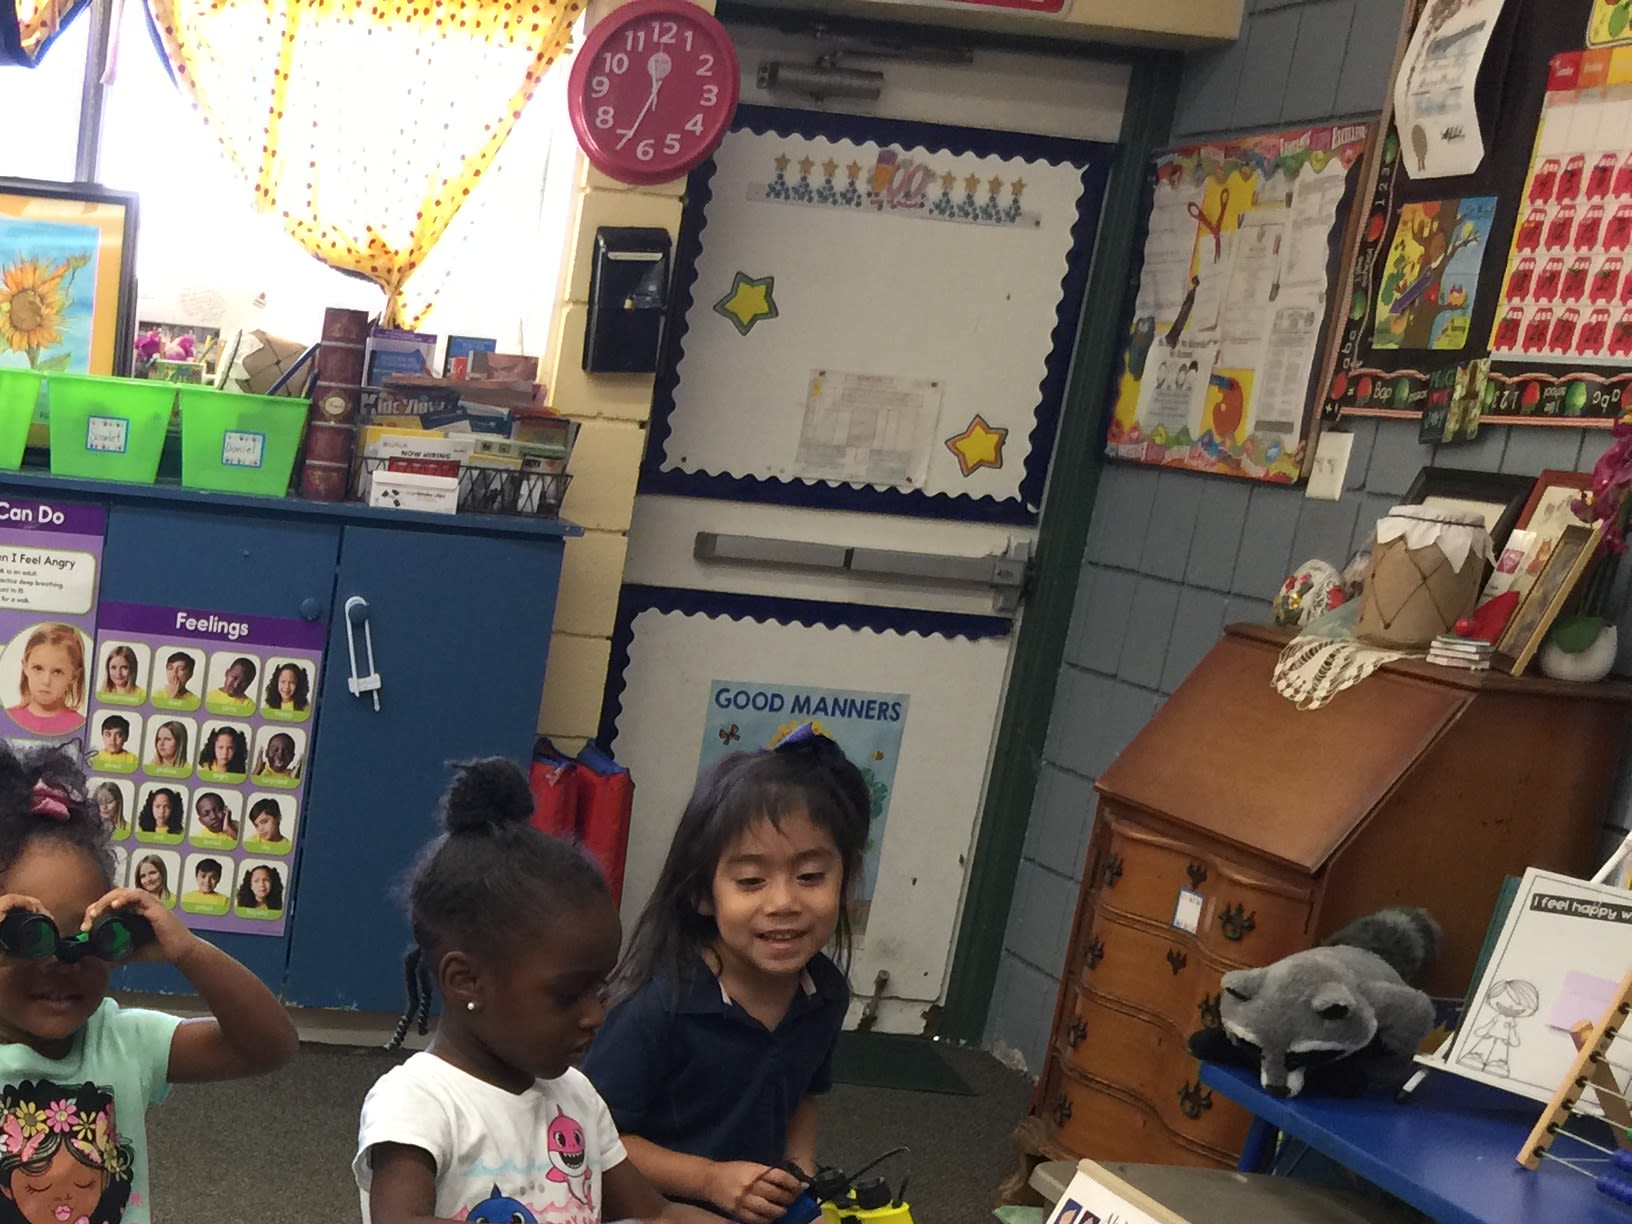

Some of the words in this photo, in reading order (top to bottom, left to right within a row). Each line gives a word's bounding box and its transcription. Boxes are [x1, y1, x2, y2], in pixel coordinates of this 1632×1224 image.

[625, 30, 645, 51] 11
[651, 22, 678, 43] 12
[684, 31, 693, 52] 1
[603, 53, 629, 75] 10
[695, 54, 714, 76] 2
[591, 76, 610, 98] 9
[700, 85, 719, 106] 3
[595, 106, 614, 129] 8
[684, 113, 704, 136] 4
[616, 128, 634, 150] 7
[636, 139, 655, 161] 6
[663, 134, 681, 155] 5
[38, 506, 65, 525] Do
[19, 554, 41, 565] Feel
[44, 556, 76, 571] Angry
[176, 612, 249, 640] Feelings
[714, 688, 785, 713] GOOD
[790, 694, 903, 722] MANNERS
[1541, 896, 1569, 911] feel
[1571, 900, 1617, 919] happy
